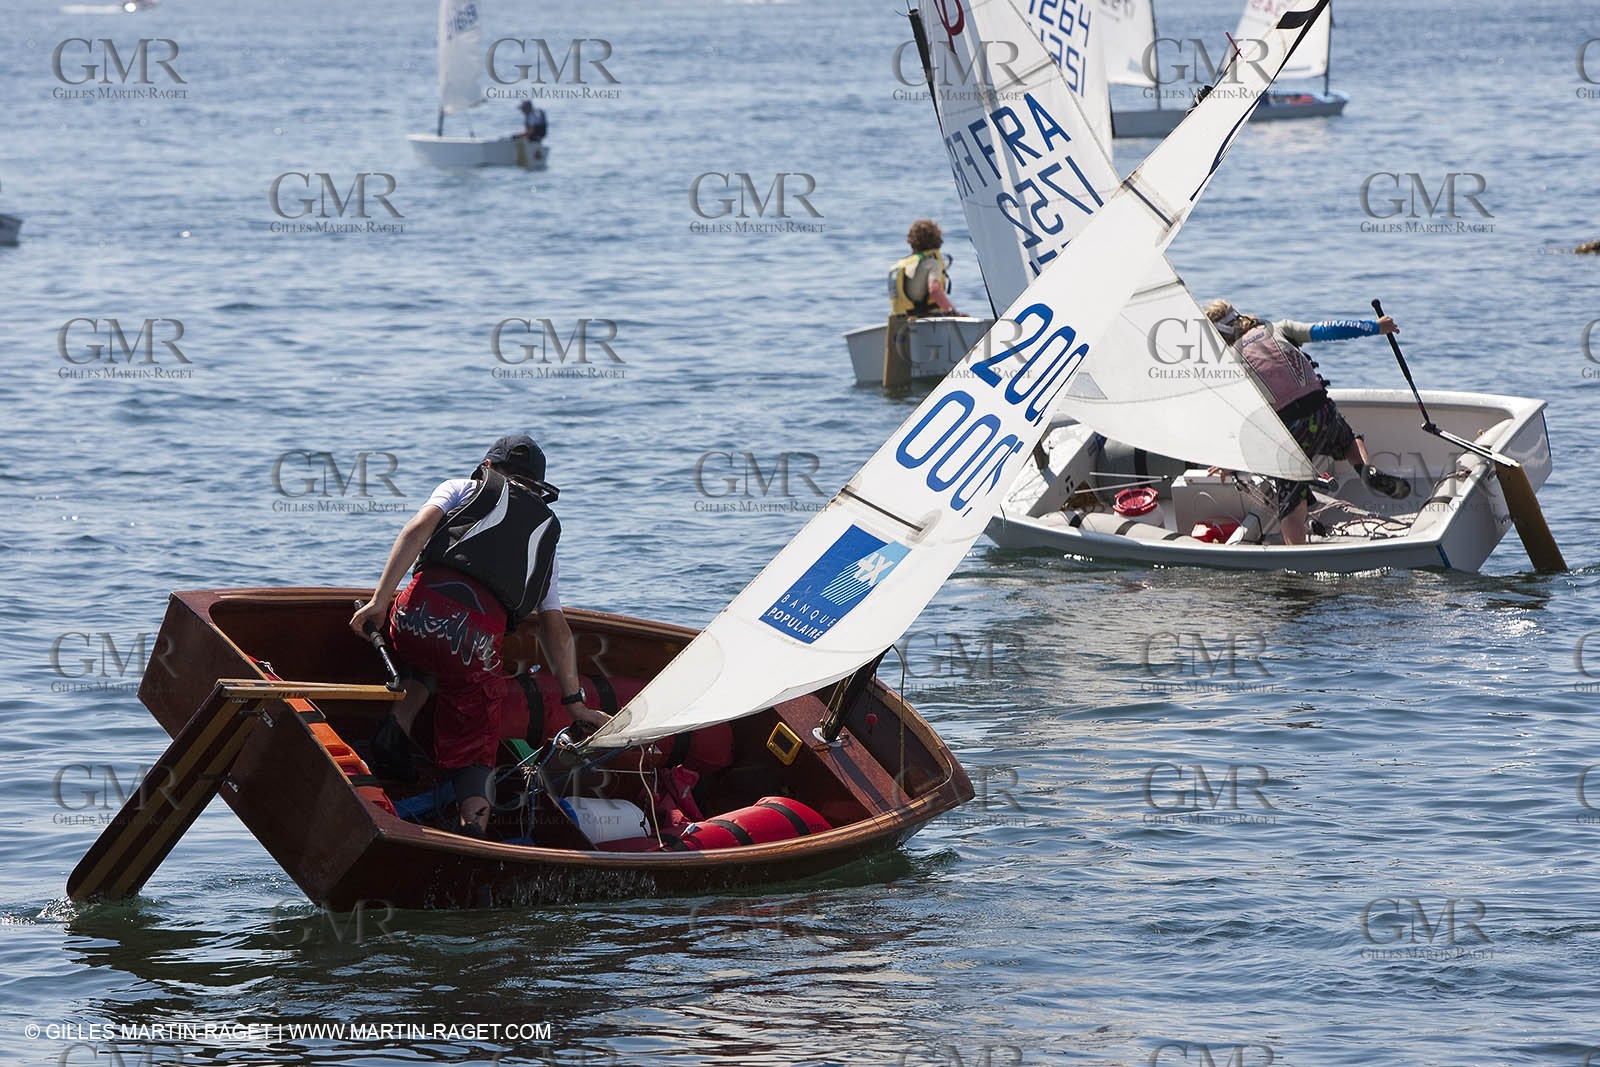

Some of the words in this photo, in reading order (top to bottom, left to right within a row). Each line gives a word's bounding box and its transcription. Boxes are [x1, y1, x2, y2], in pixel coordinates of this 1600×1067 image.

[968, 93, 1071, 180] FRA
[767, 607, 824, 640] POPULAIRE
[781, 594, 837, 627] BANQUE
